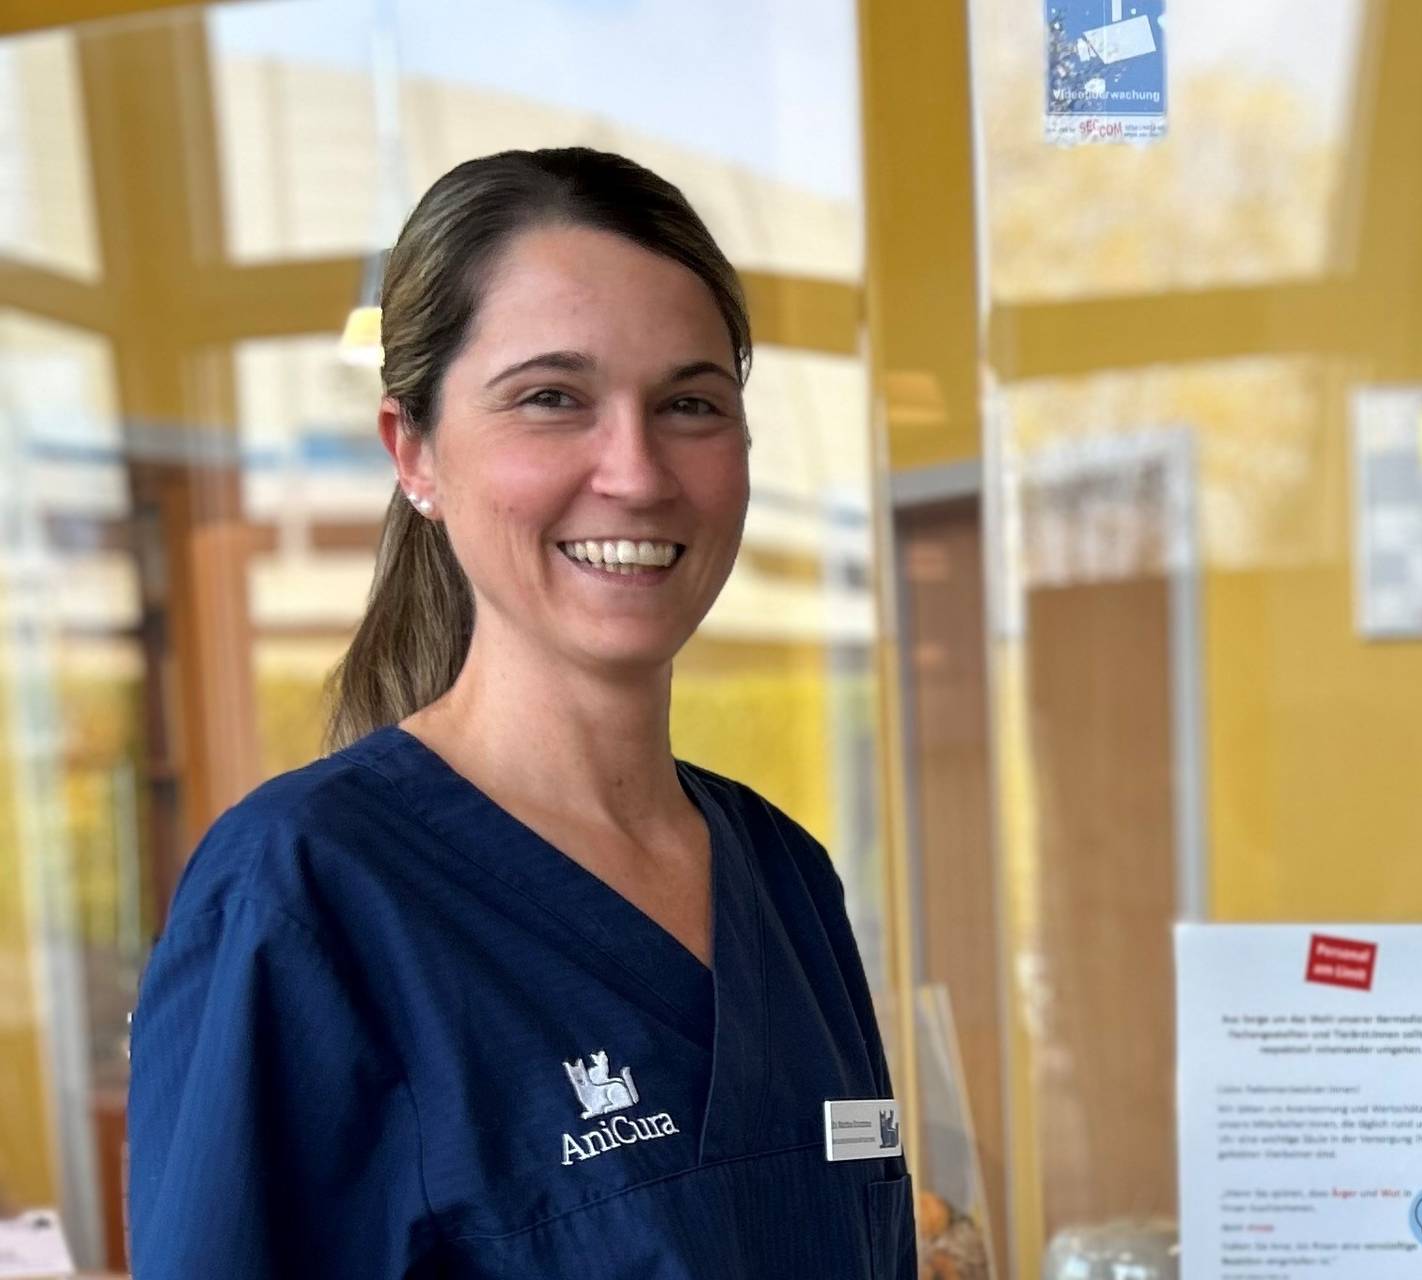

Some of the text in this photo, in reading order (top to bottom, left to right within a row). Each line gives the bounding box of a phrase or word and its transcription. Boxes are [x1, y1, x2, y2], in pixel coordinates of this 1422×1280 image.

[1316, 942, 1371, 962] Personal
[1313, 963, 1367, 982] am Limit
[561, 1111, 679, 1166] AniCura
